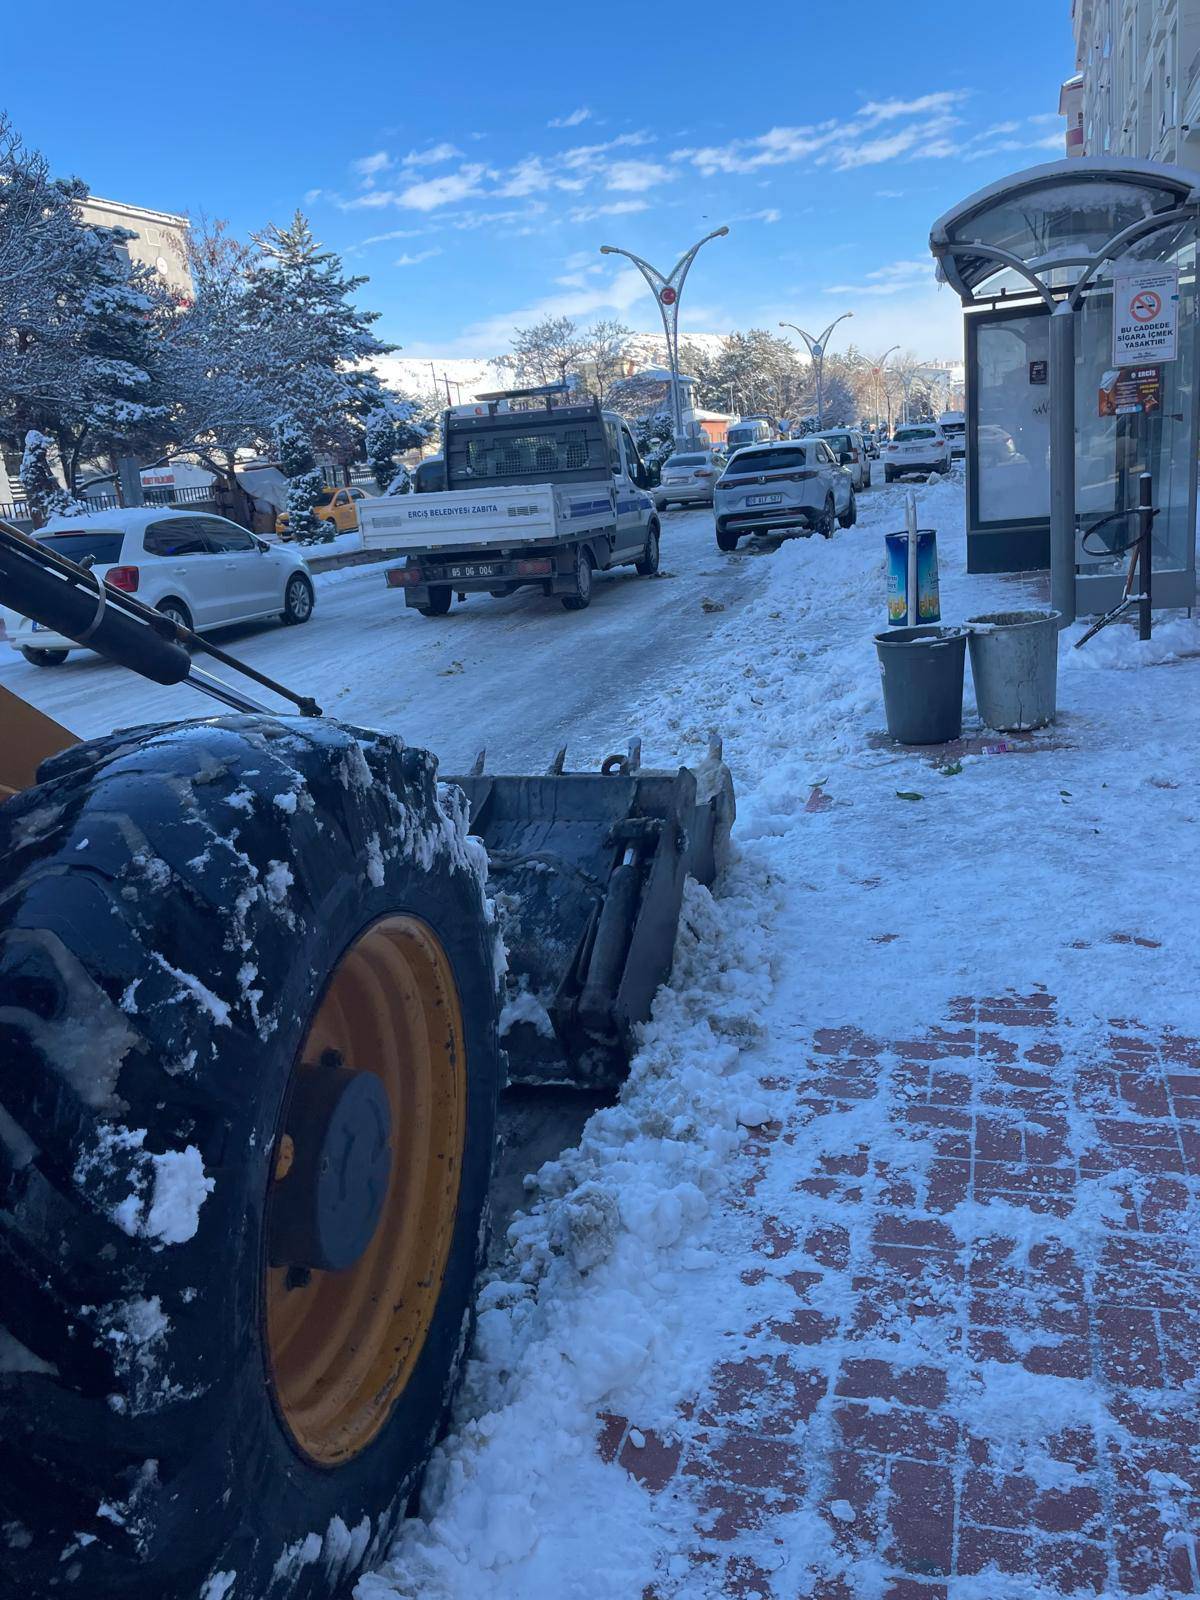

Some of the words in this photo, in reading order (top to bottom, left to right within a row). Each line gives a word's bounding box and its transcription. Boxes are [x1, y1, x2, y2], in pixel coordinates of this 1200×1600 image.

[1133, 322, 1170, 331] CADDEDE
[1117, 333, 1146, 341] SİGARA
[1148, 329, 1174, 338] İÇMEK
[1125, 339, 1166, 348] YASAKTIR!
[472, 505, 498, 513] ZABITA
[479, 565, 493, 575] 004
